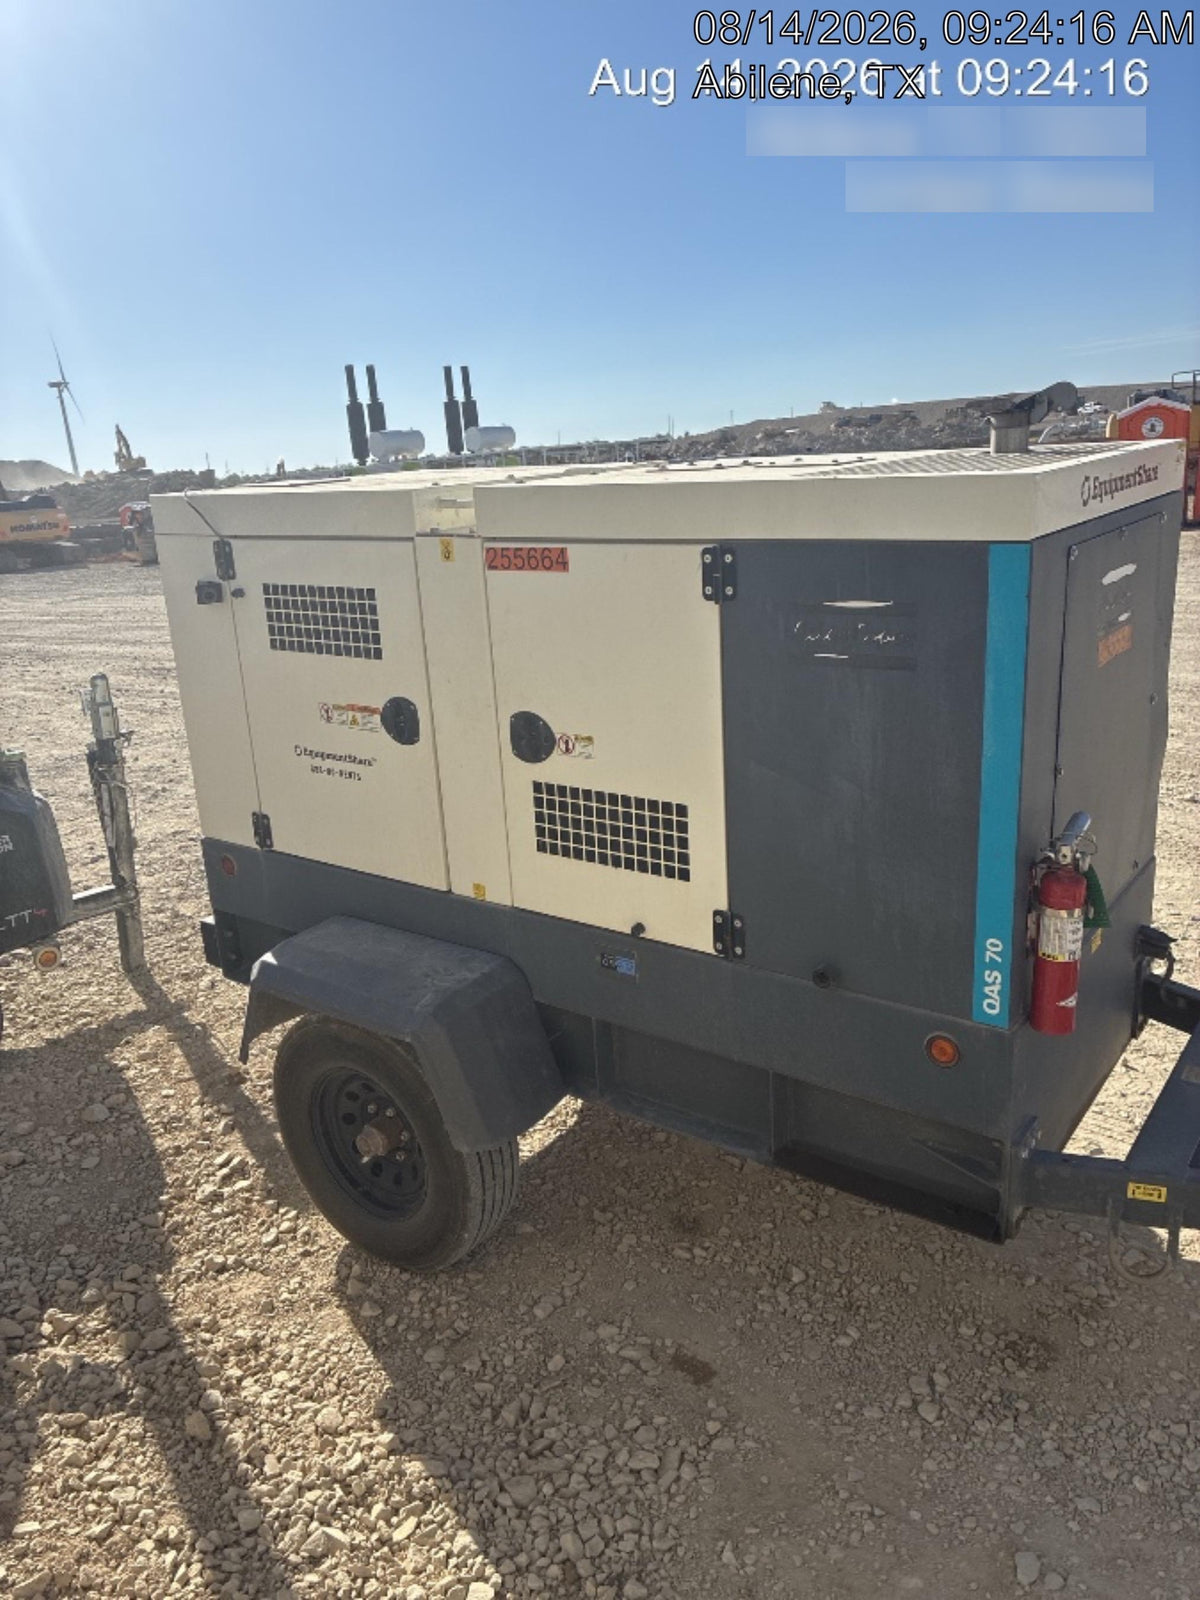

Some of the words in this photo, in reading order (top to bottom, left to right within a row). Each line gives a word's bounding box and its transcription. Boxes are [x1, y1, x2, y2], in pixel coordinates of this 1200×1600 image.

[485, 546, 568, 571] 255664
[0, 908, 49, 931] TT4
[984, 937, 1004, 963] 70
[982, 969, 1002, 1016] QAS
